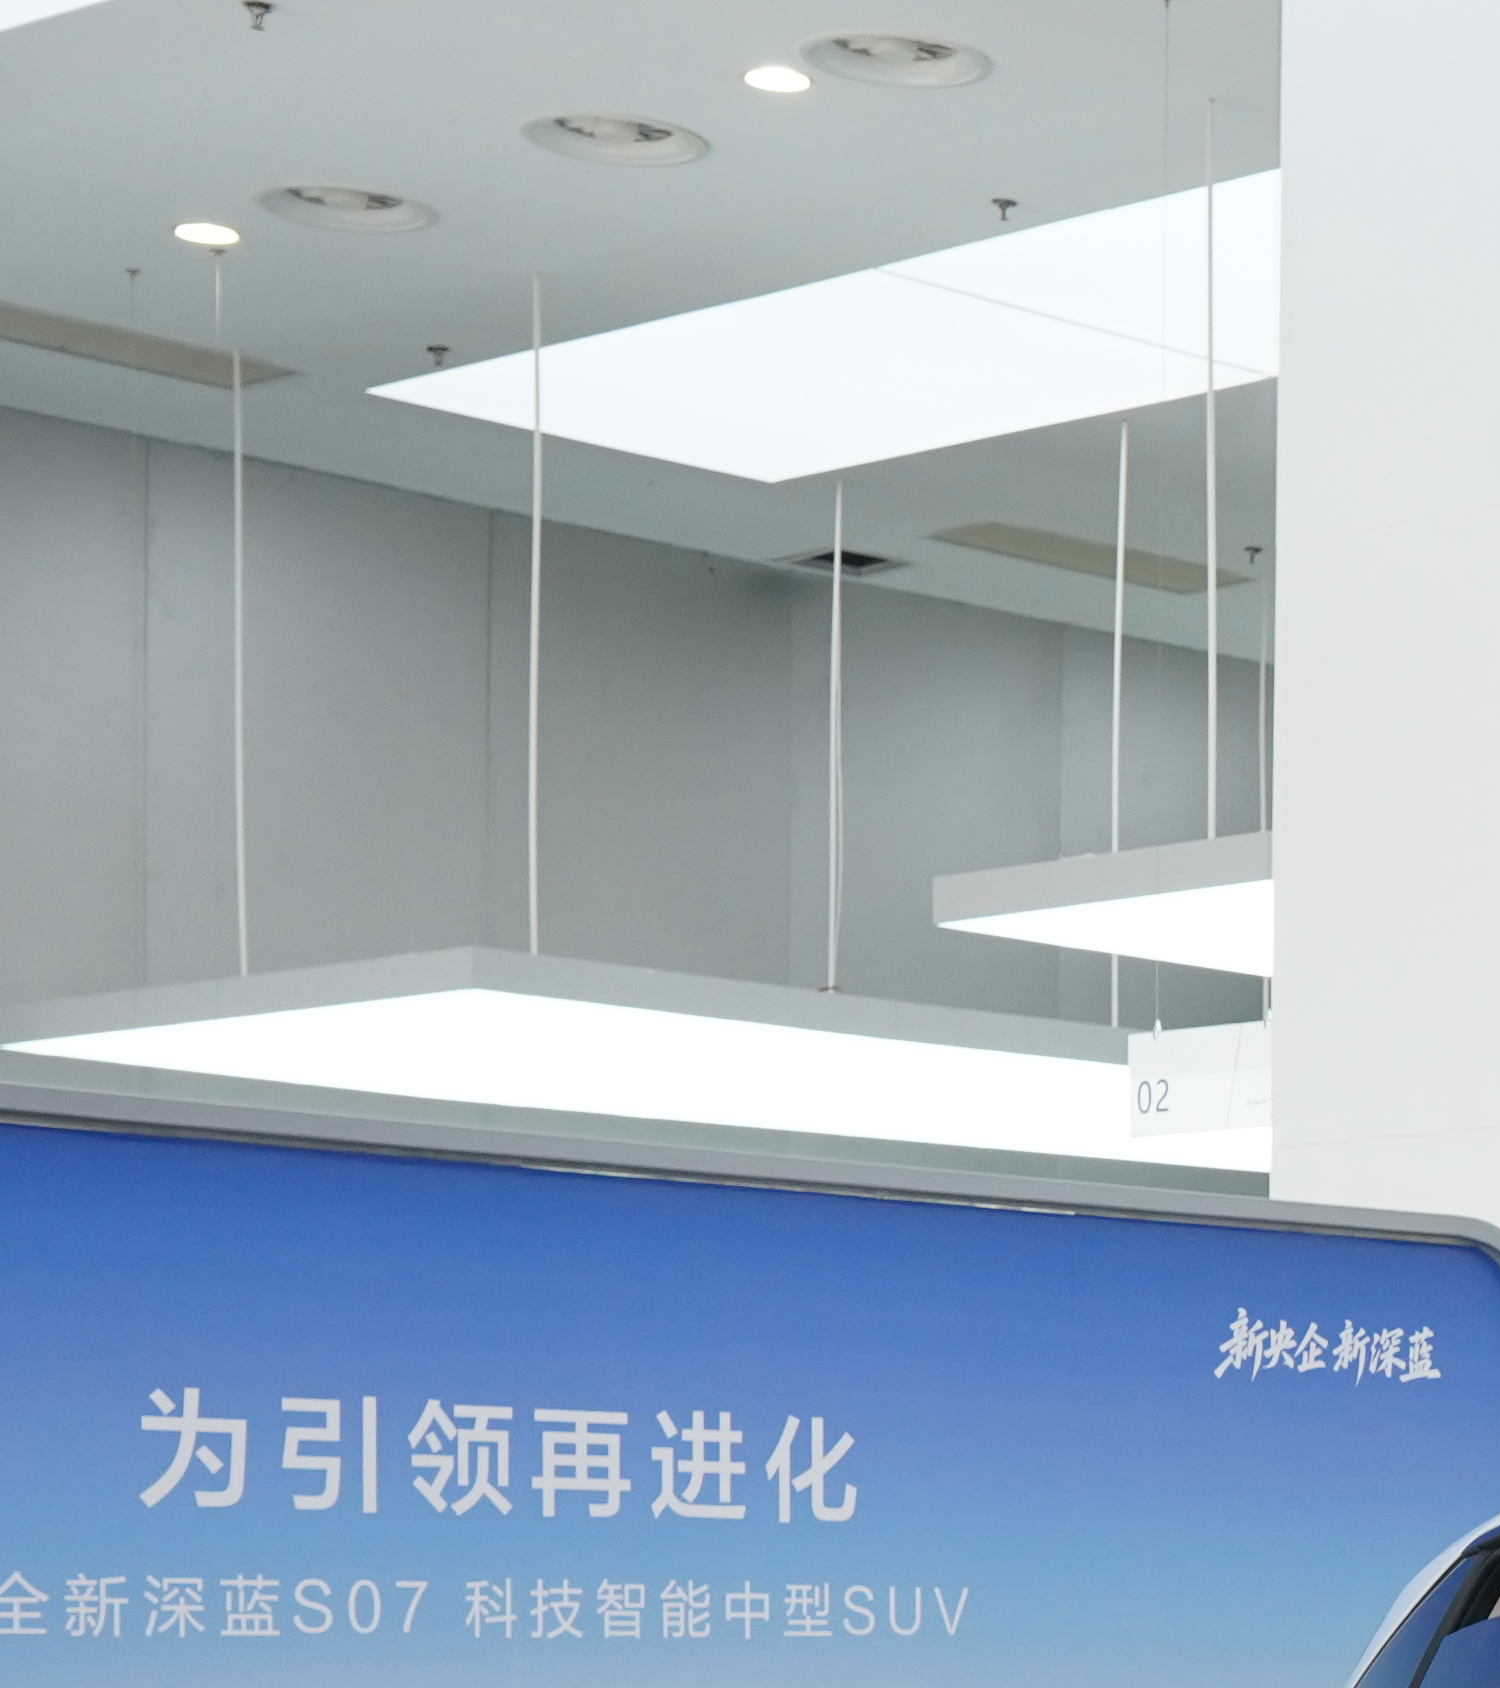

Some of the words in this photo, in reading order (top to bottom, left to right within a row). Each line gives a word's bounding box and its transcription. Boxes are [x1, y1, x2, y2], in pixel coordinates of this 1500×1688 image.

[1137, 1079, 1170, 1114] 02
[138, 1386, 860, 1524] 为引领再进化
[0, 1570, 429, 1638] 全新深蓝S07
[464, 1578, 971, 1641] 科技智能中型SUV
